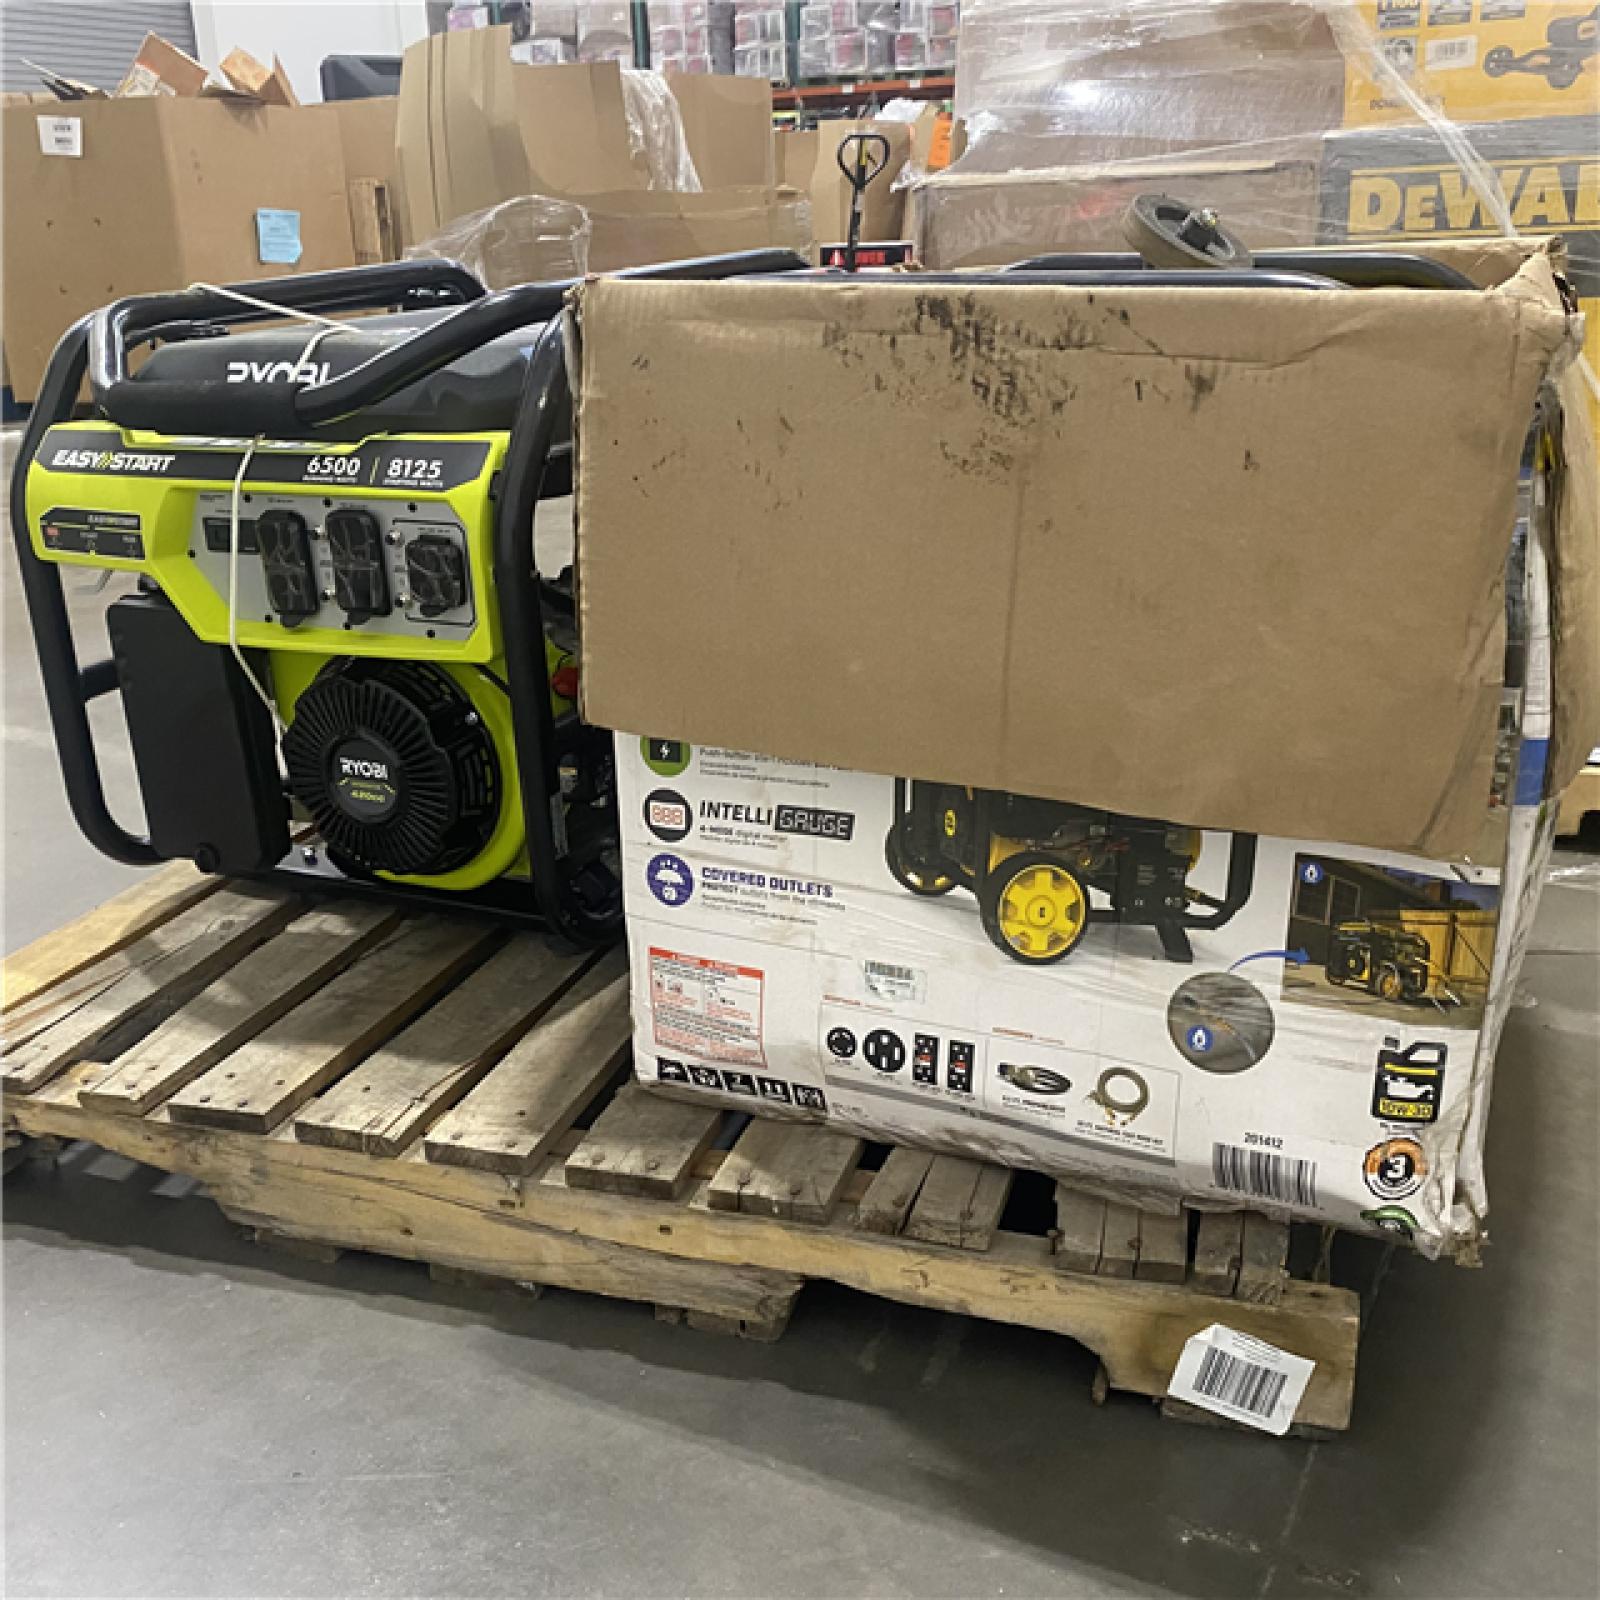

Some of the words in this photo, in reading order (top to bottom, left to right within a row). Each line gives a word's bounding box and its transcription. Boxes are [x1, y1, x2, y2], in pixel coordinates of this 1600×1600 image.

[51, 449, 101, 468] EASY
[109, 452, 176, 472] START
[306, 456, 361, 476] 6500
[387, 457, 443, 479] 8125
[340, 756, 388, 780] RYOBI
[700, 799, 773, 826] INTELLI
[778, 807, 850, 838] GAUGE
[702, 866, 766, 888] COVERED
[769, 876, 834, 898] OUTLETS
[1385, 1153, 1407, 1179] 3
